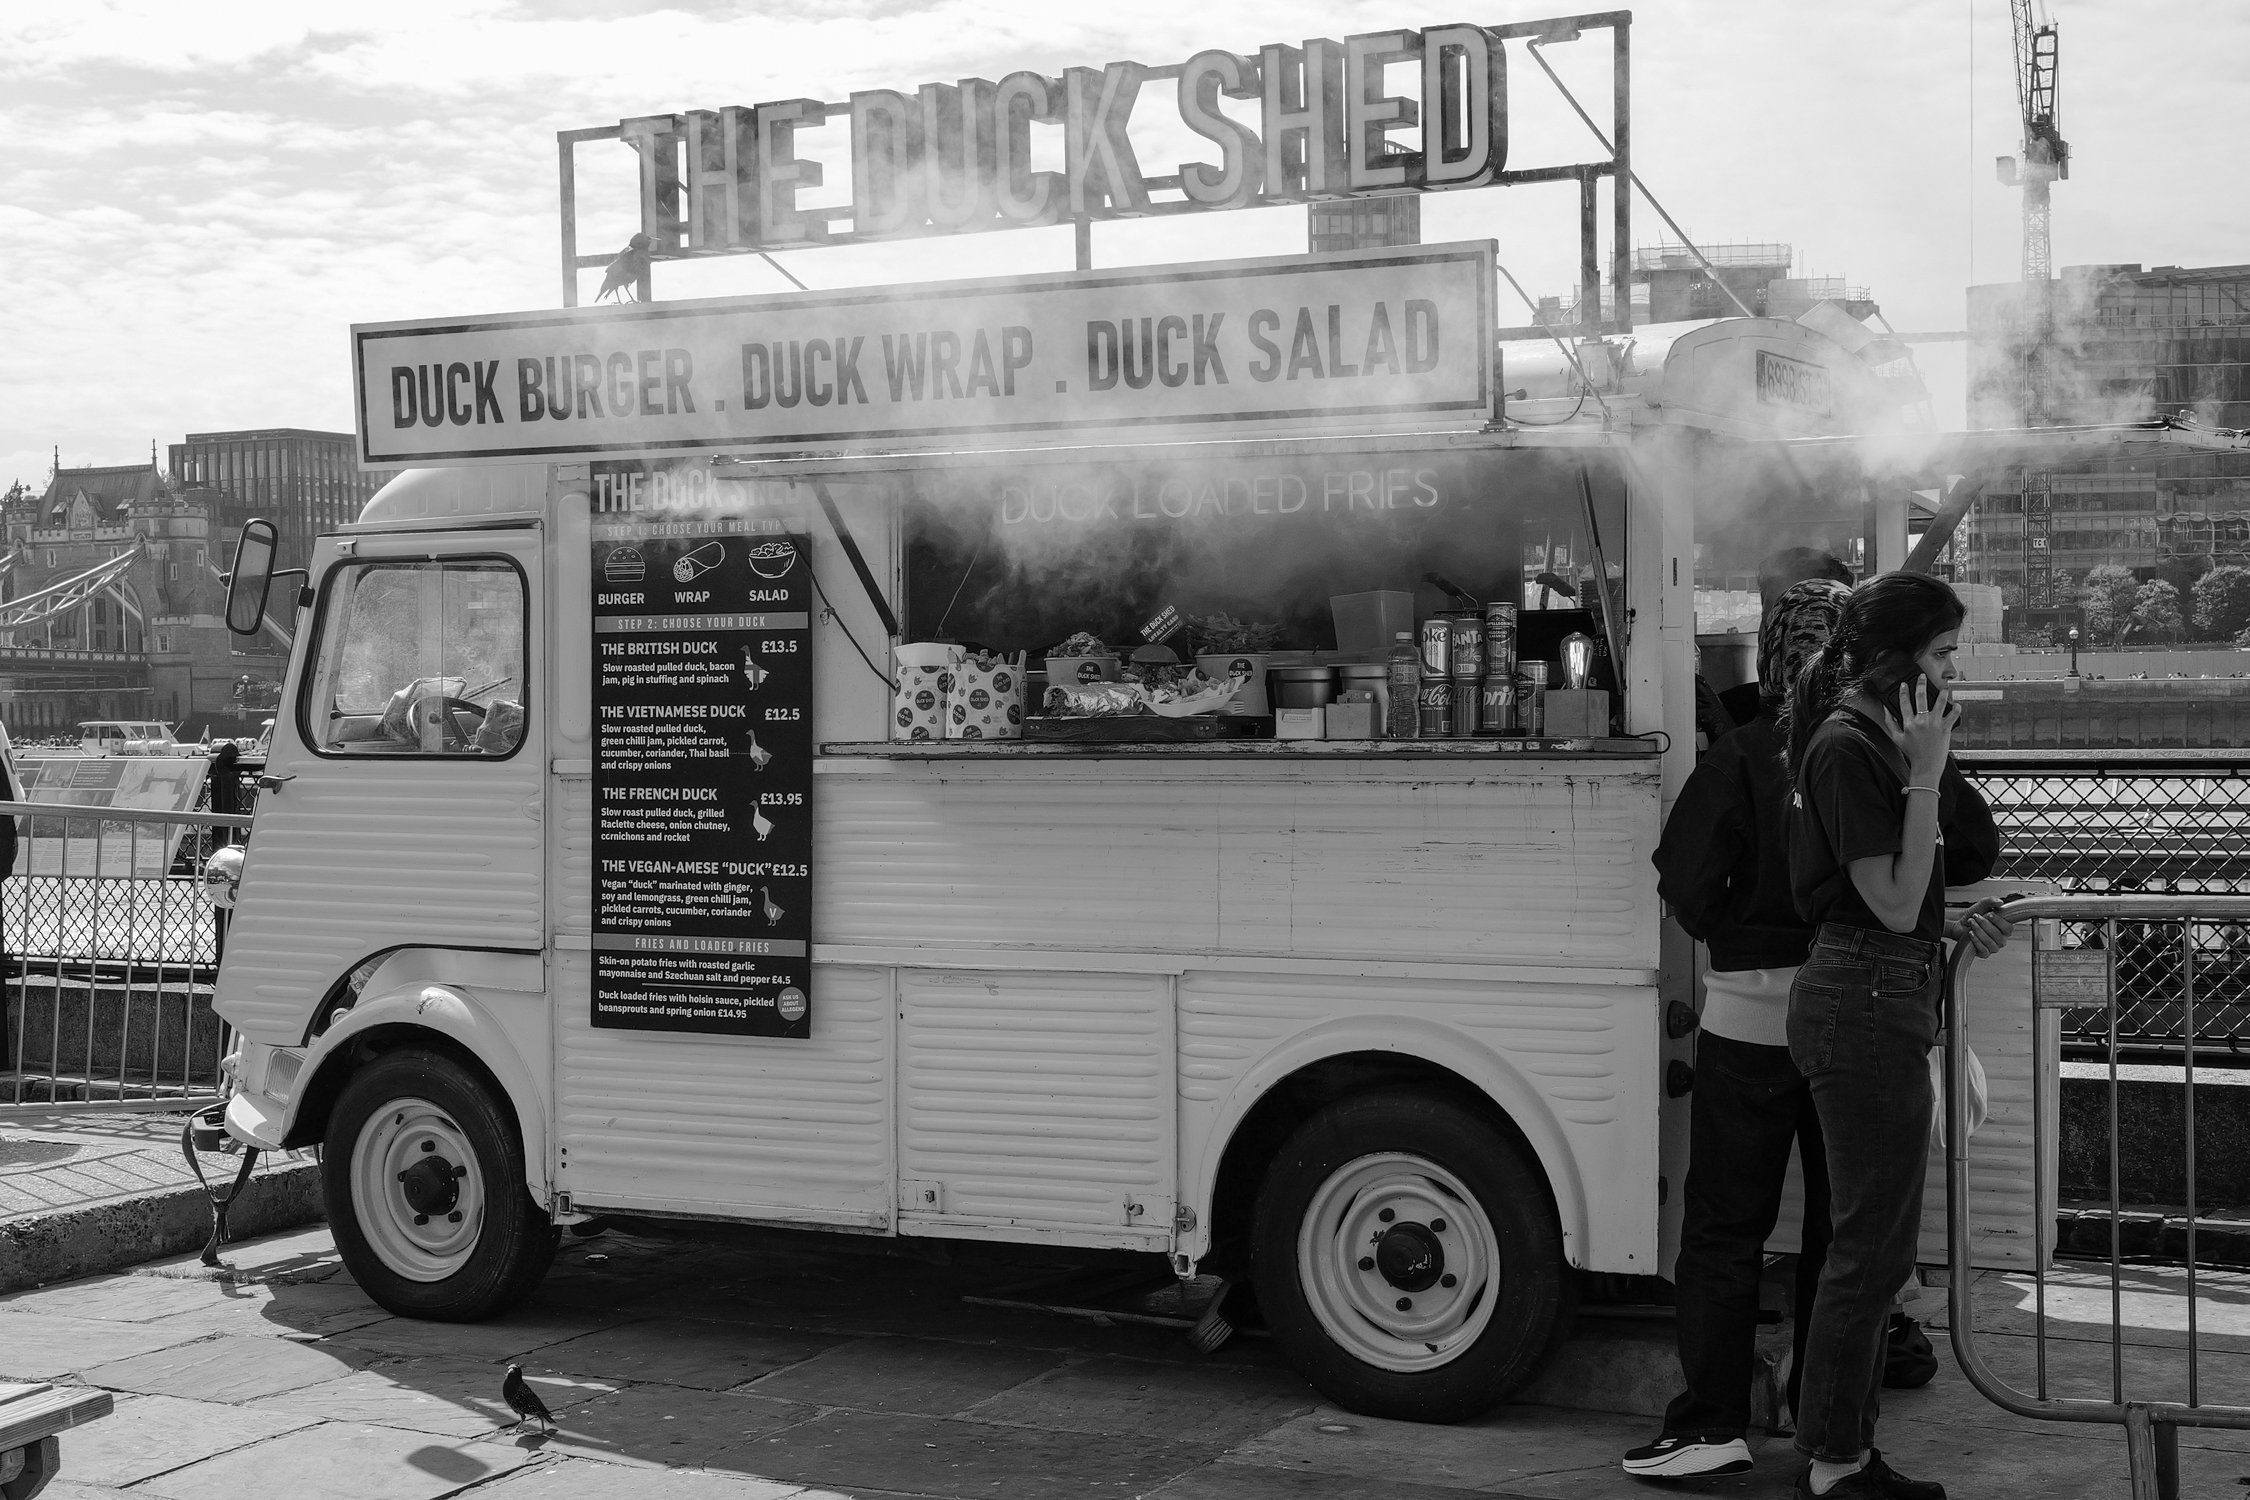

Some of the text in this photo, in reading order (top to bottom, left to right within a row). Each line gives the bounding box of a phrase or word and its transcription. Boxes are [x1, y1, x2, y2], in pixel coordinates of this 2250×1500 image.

[620, 23, 1506, 259] THE DUCK SHED
[391, 299, 1440, 429] DUCK BURGER DUCK WRAP DUCK SALAD
[594, 472, 644, 512] THE
[652, 468, 723, 511] DUCK
[1002, 468, 1439, 525] DUCK LOADED FRIES
[607, 526, 632, 538] STEP
[638, 525, 648, 536] 1:
[652, 522, 692, 535] CHOOSE
[697, 521, 723, 533] YOUR
[728, 519, 756, 532] MEAL
[598, 592, 645, 605] BURGER
[674, 591, 710, 603] WRAP
[749, 589, 789, 602] SALAD
[618, 616, 765, 630] STEP 2: CHOOSE YOUR DUCK
[1140, 604, 1176, 637] THE DUCK SHED
[600, 640, 797, 655] THE BRITISH DUCK £13.5
[603, 661, 735, 674] Slow roasted pulled duck, bacon
[602, 673, 729, 686] jam, pig in stuffing and spinach
[600, 705, 800, 721] THE VIETNAMESE DUCK £12.5
[601, 723, 706, 735] Slow roasted pulled duck,
[601, 735, 727, 747] green chilli jam, pickled carrot,
[601, 748, 730, 759] cucumber, coriander, Thai basil
[601, 760, 672, 772] and crispy onions
[602, 787, 803, 805] THE FRENCH DUCK £13.95
[601, 807, 725, 820] Slow roast pulled duck, grilled
[601, 819, 731, 832] Raclette cheese, onion chutney,
[646, 832, 662, 841] and
[663, 832, 690, 842] rocket
[601, 859, 808, 877] THE VEGAN-AMESE “DUCK” £12.5
[601, 879, 753, 894] Vegan “duck” marinated with ginger,
[601, 891, 752, 906] soy and lemongrass, green chilli jam,
[601, 903, 752, 917] pickled carrots, cucumber, coriander
[601, 916, 672, 928] and crispy onions
[635, 937, 769, 953] FRIES AND LOADED FRIES
[599, 955, 755, 972] Skin-on potato fries with roasted garlic
[599, 969, 791, 985] mayonnaise and Szechuan salt and pepper £4.5
[598, 990, 774, 1008] Duck loaded fries with hoisin sauce, pickled
[598, 1002, 747, 1019] beansprouts and spring onion £14.95
